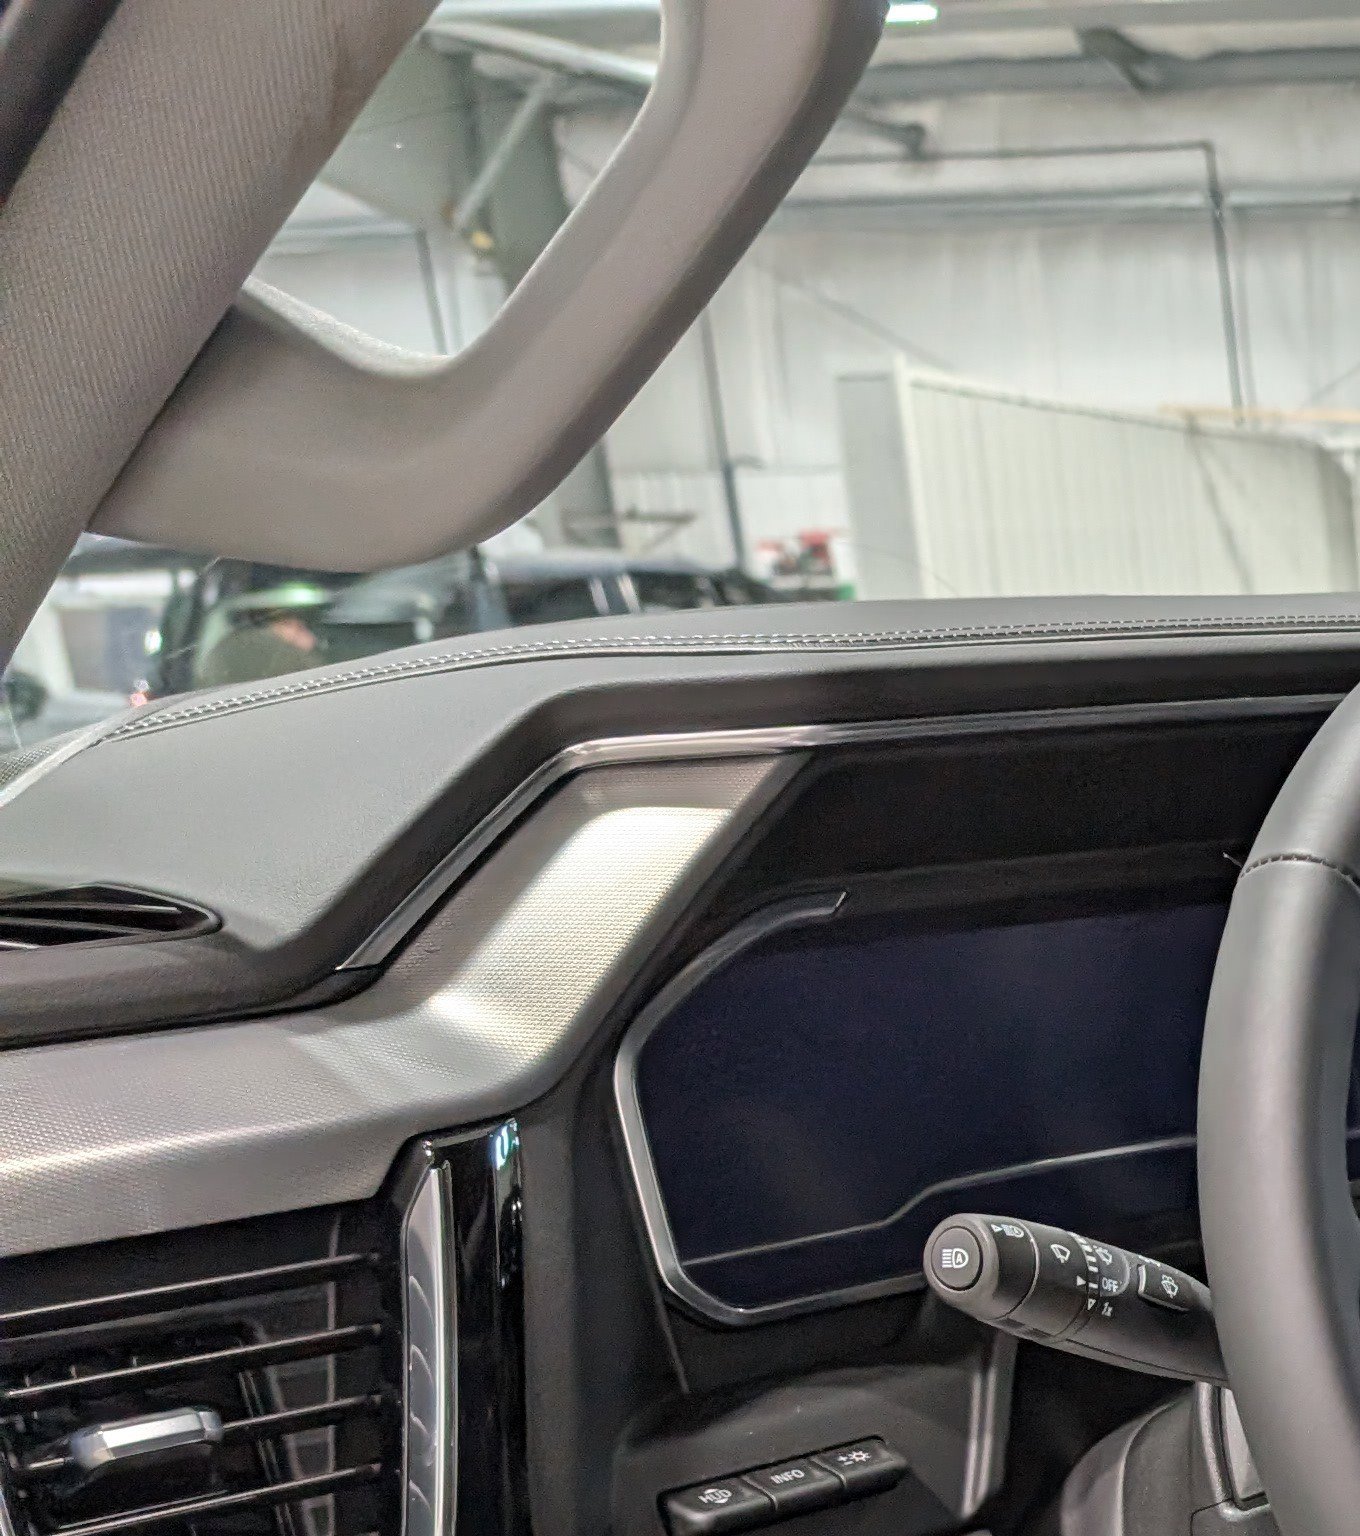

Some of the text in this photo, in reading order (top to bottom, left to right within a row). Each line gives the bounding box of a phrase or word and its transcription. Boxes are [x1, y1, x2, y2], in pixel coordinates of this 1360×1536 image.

[1102, 1277, 1119, 1293] OFF
[770, 1468, 805, 1484] INFO
[699, 1488, 732, 1504] HUD
